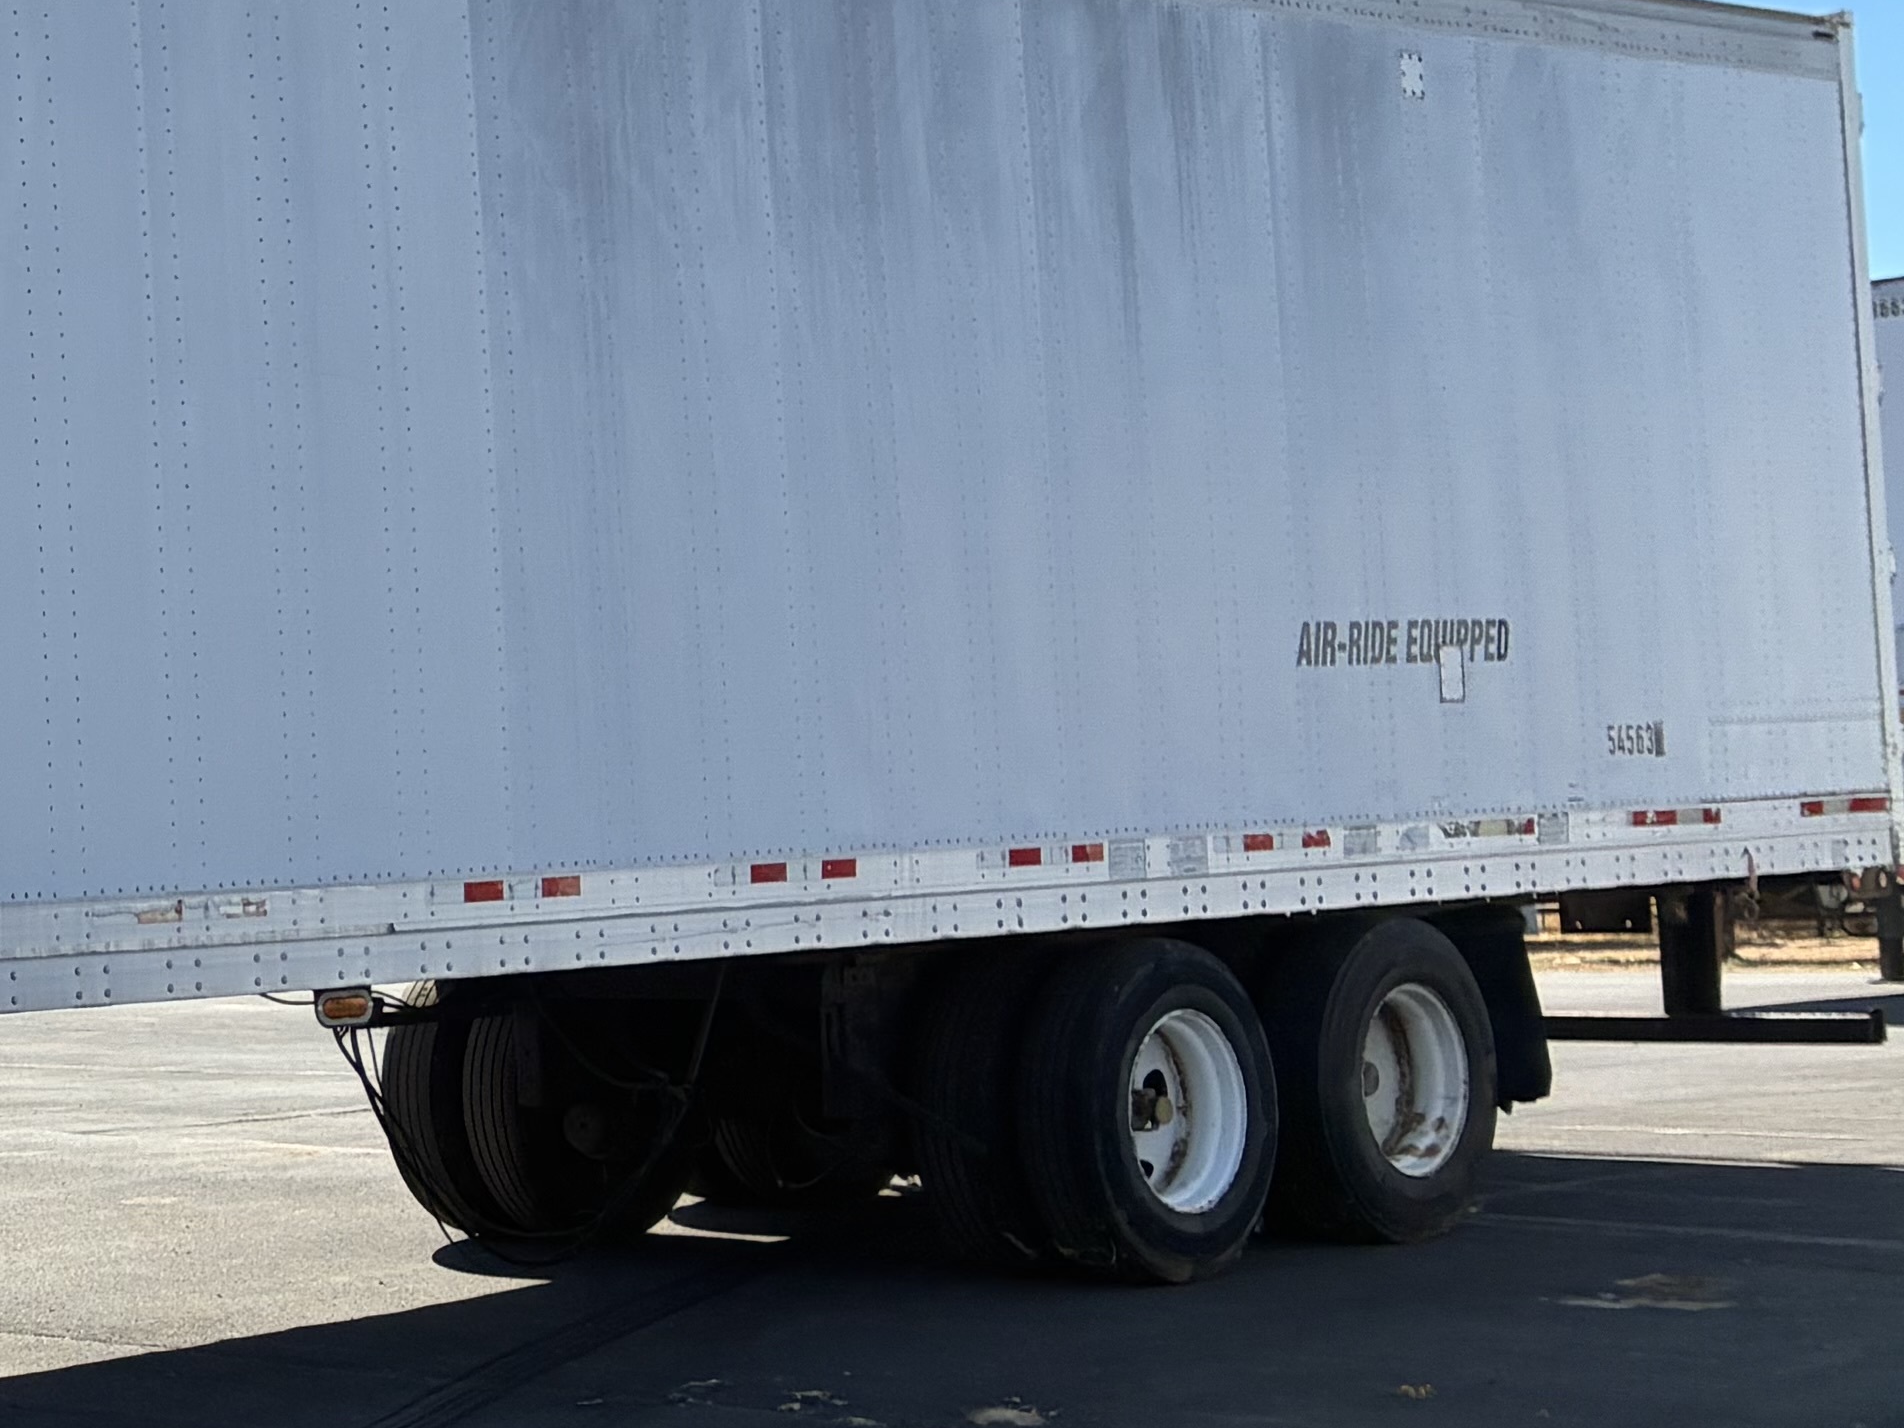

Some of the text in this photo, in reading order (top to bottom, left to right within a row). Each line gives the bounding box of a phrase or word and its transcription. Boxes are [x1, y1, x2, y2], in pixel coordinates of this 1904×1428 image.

[1296, 618, 1510, 667] AIR-RIDE EQUIPPED
[1607, 721, 1666, 757] 54563
